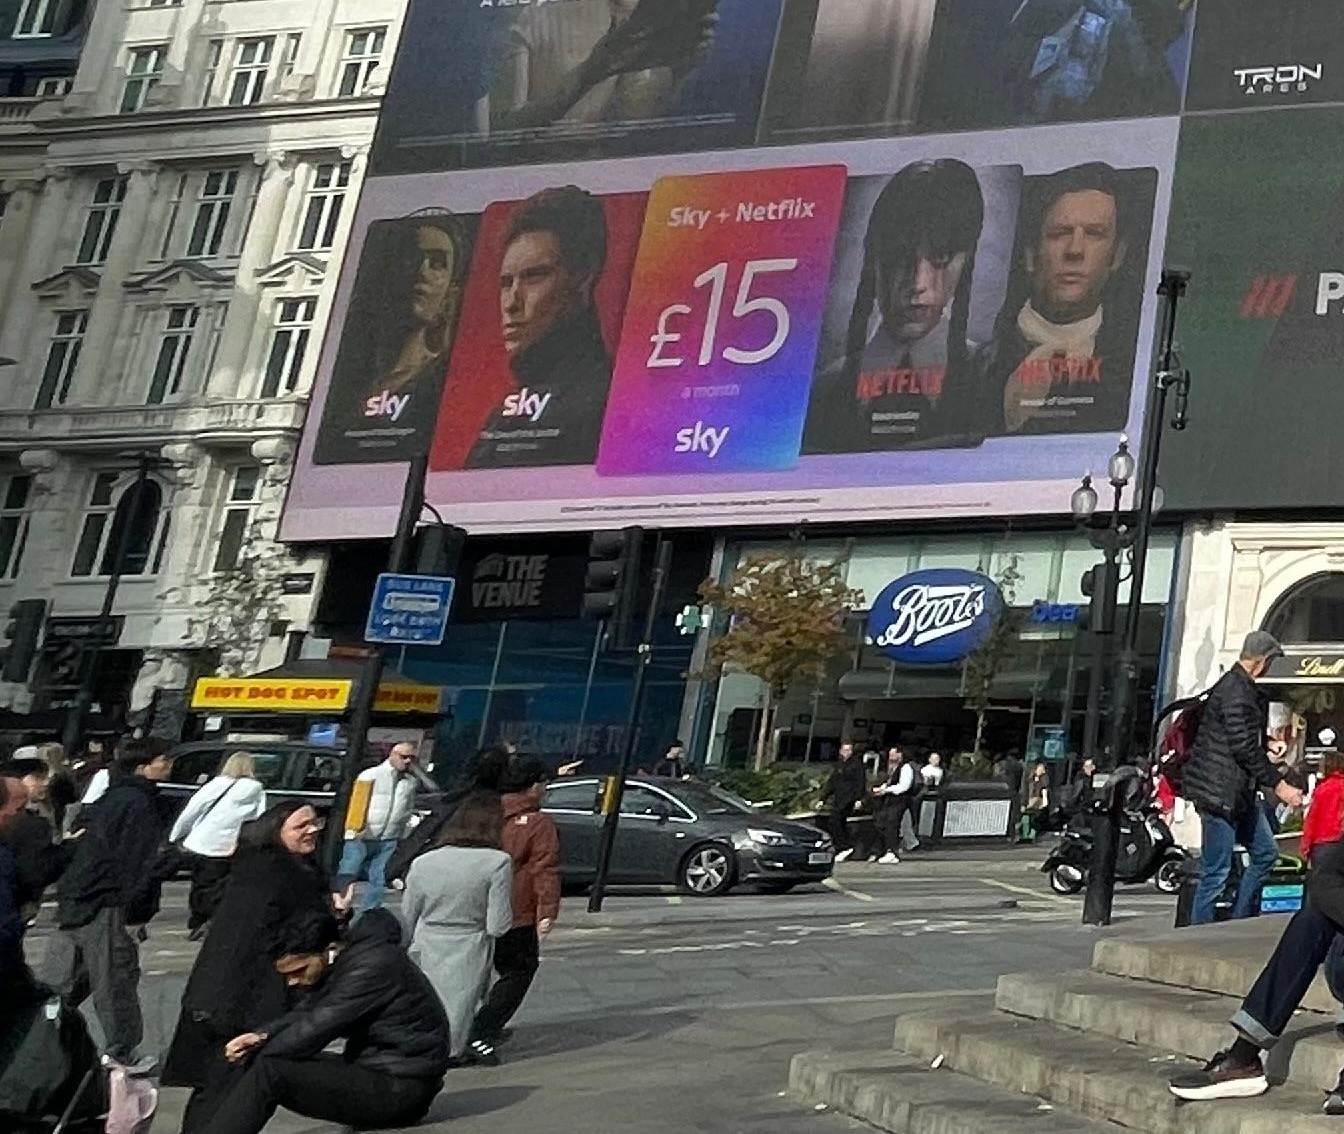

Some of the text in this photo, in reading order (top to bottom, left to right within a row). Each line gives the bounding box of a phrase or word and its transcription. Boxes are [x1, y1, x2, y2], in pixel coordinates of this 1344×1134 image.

[1234, 63, 1322, 86] TRON
[667, 206, 711, 229] Sky
[736, 197, 816, 222] Netflix
[647, 258, 797, 368] £15
[365, 390, 411, 421] sky
[502, 387, 551, 421] sky
[674, 420, 730, 458] sky
[507, 554, 549, 580] THE
[472, 581, 543, 607] VENUE
[876, 584, 986, 646] Boots
[205, 686, 243, 699] HOT
